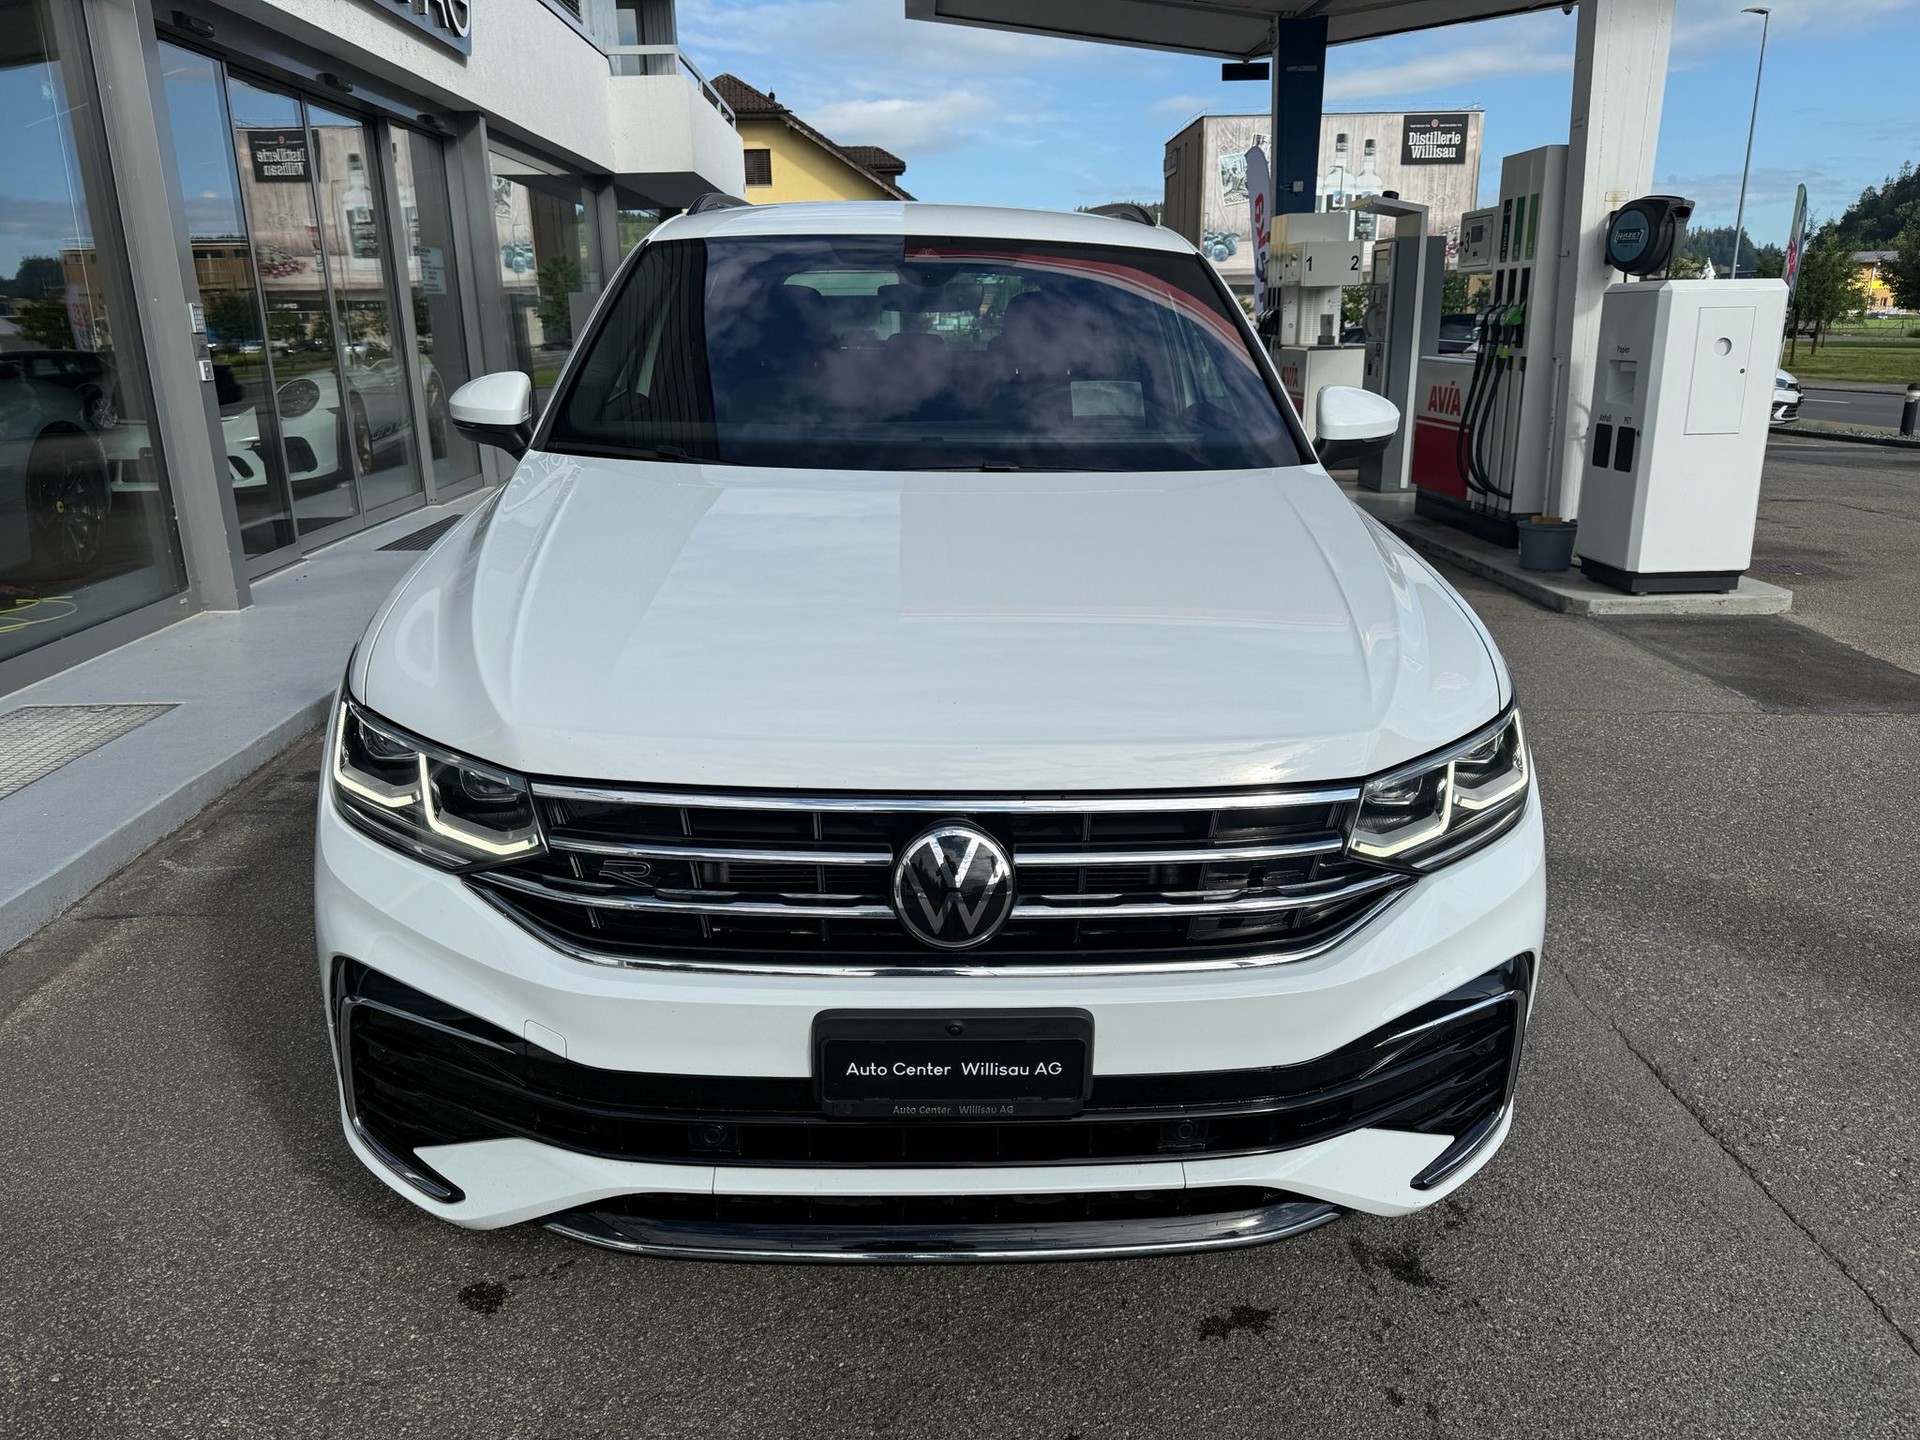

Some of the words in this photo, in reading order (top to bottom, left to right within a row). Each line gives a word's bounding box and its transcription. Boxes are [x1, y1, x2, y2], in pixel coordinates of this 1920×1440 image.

[1408, 131, 1461, 145] Distillerie
[1411, 145, 1456, 159] Willisau
[1464, 231, 1470, 253] 3
[1306, 256, 1313, 271] 1
[1350, 255, 1359, 271] 2
[1427, 380, 1461, 416] AVIA
[846, 1062, 887, 1076] Auto
[893, 1062, 952, 1076] Center
[961, 1062, 1029, 1076] Willisau
[1034, 1062, 1063, 1075] AG
[892, 1105, 917, 1115] Auto
[919, 1105, 952, 1115] Center
[959, 1105, 997, 1115] Willisau
[999, 1105, 1014, 1114] AG
